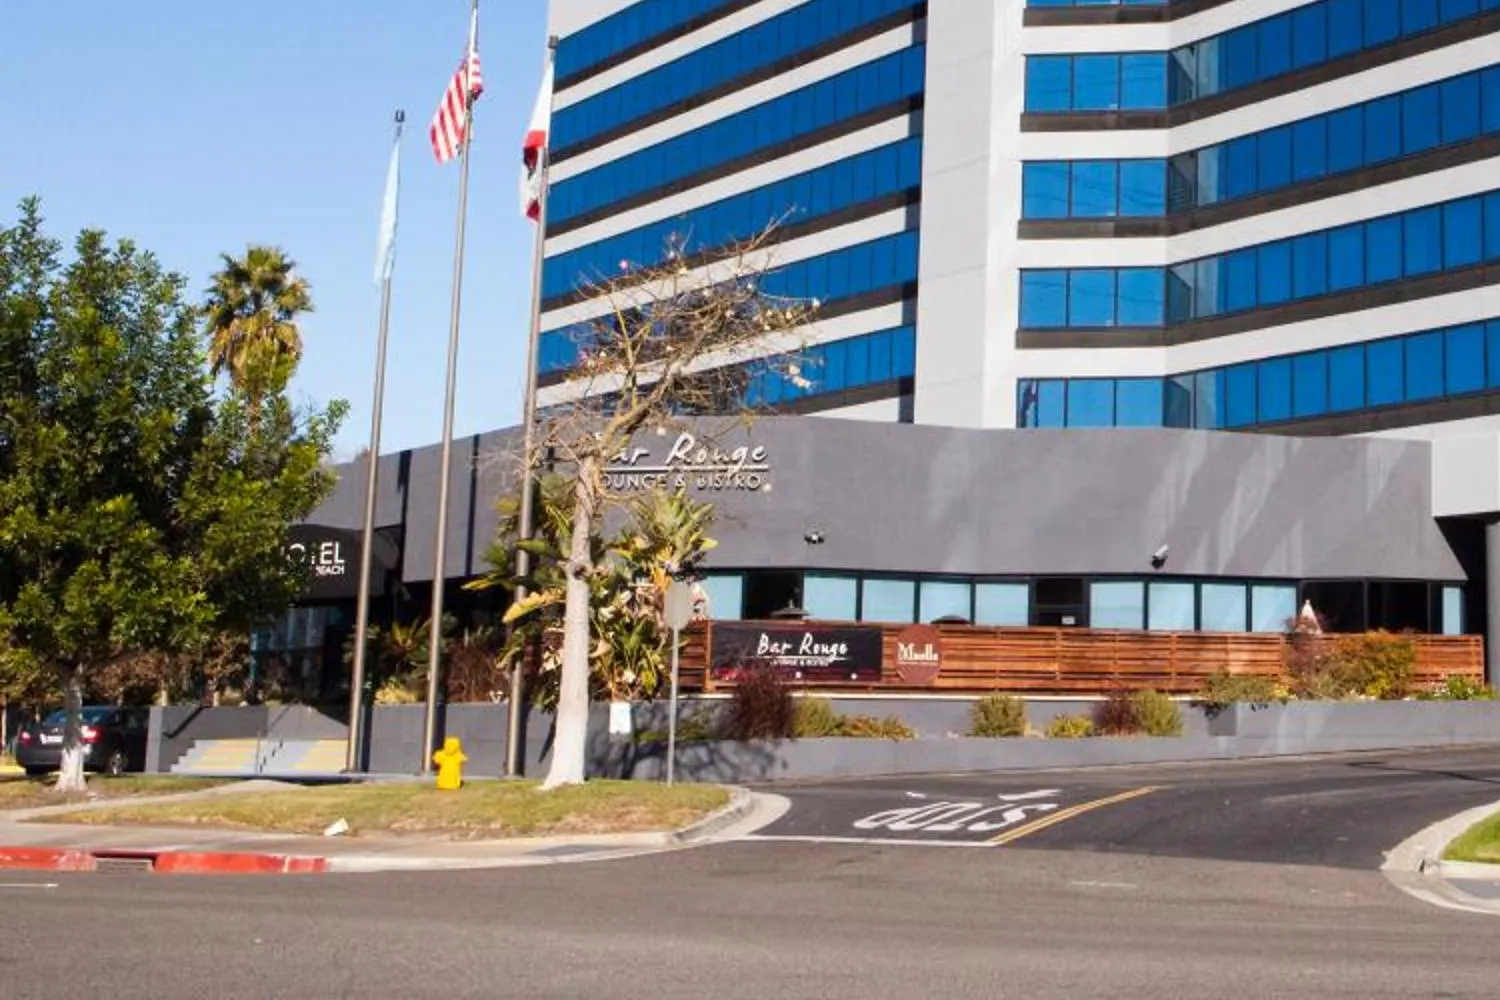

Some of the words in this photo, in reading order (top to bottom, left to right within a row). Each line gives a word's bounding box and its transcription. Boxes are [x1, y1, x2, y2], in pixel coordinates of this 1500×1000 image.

[756, 632, 793, 656] Bar
[799, 632, 850, 662] Rouge
[853, 801, 1058, 832] STOP
